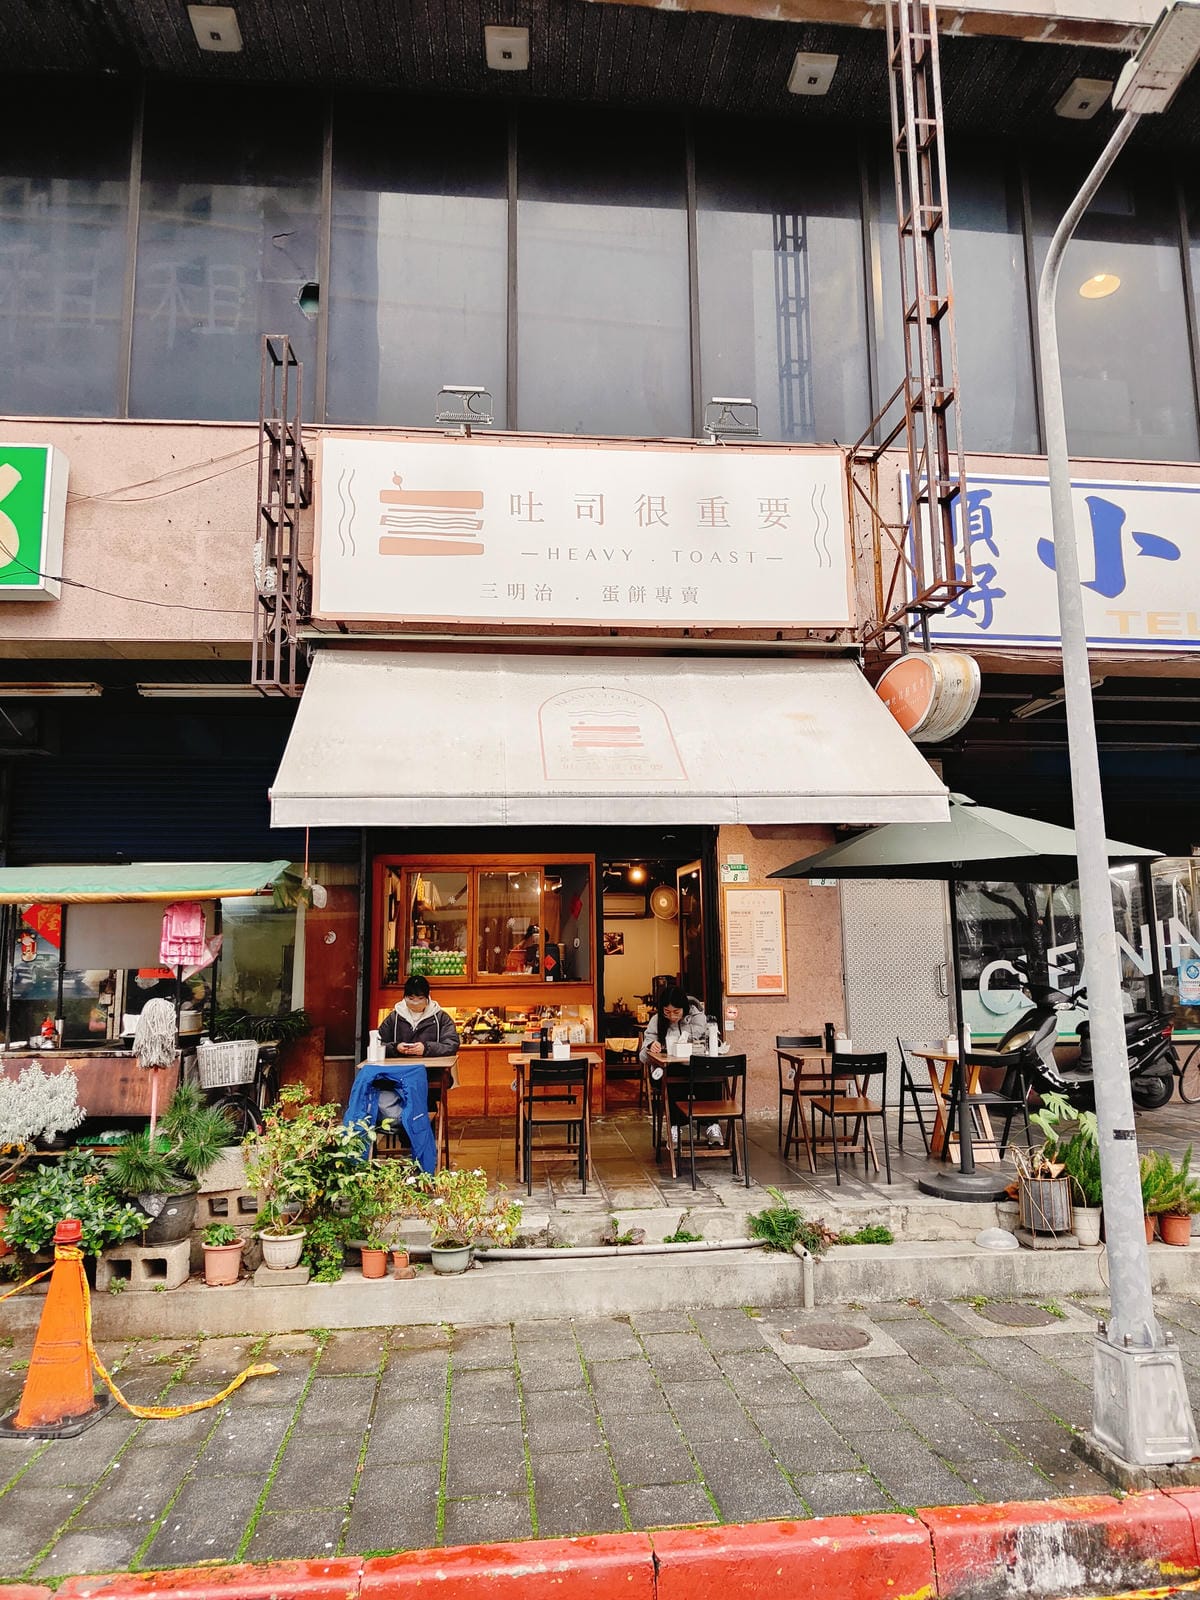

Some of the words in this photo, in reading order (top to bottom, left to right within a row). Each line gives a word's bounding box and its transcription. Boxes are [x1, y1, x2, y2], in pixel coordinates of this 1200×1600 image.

[509, 490, 791, 530] 吐司很重要
[547, 547, 633, 562] HEAVY
[671, 549, 757, 564] TOAST
[480, 582, 553, 603] 三明治
[601, 584, 700, 605] 蛋餅專賣
